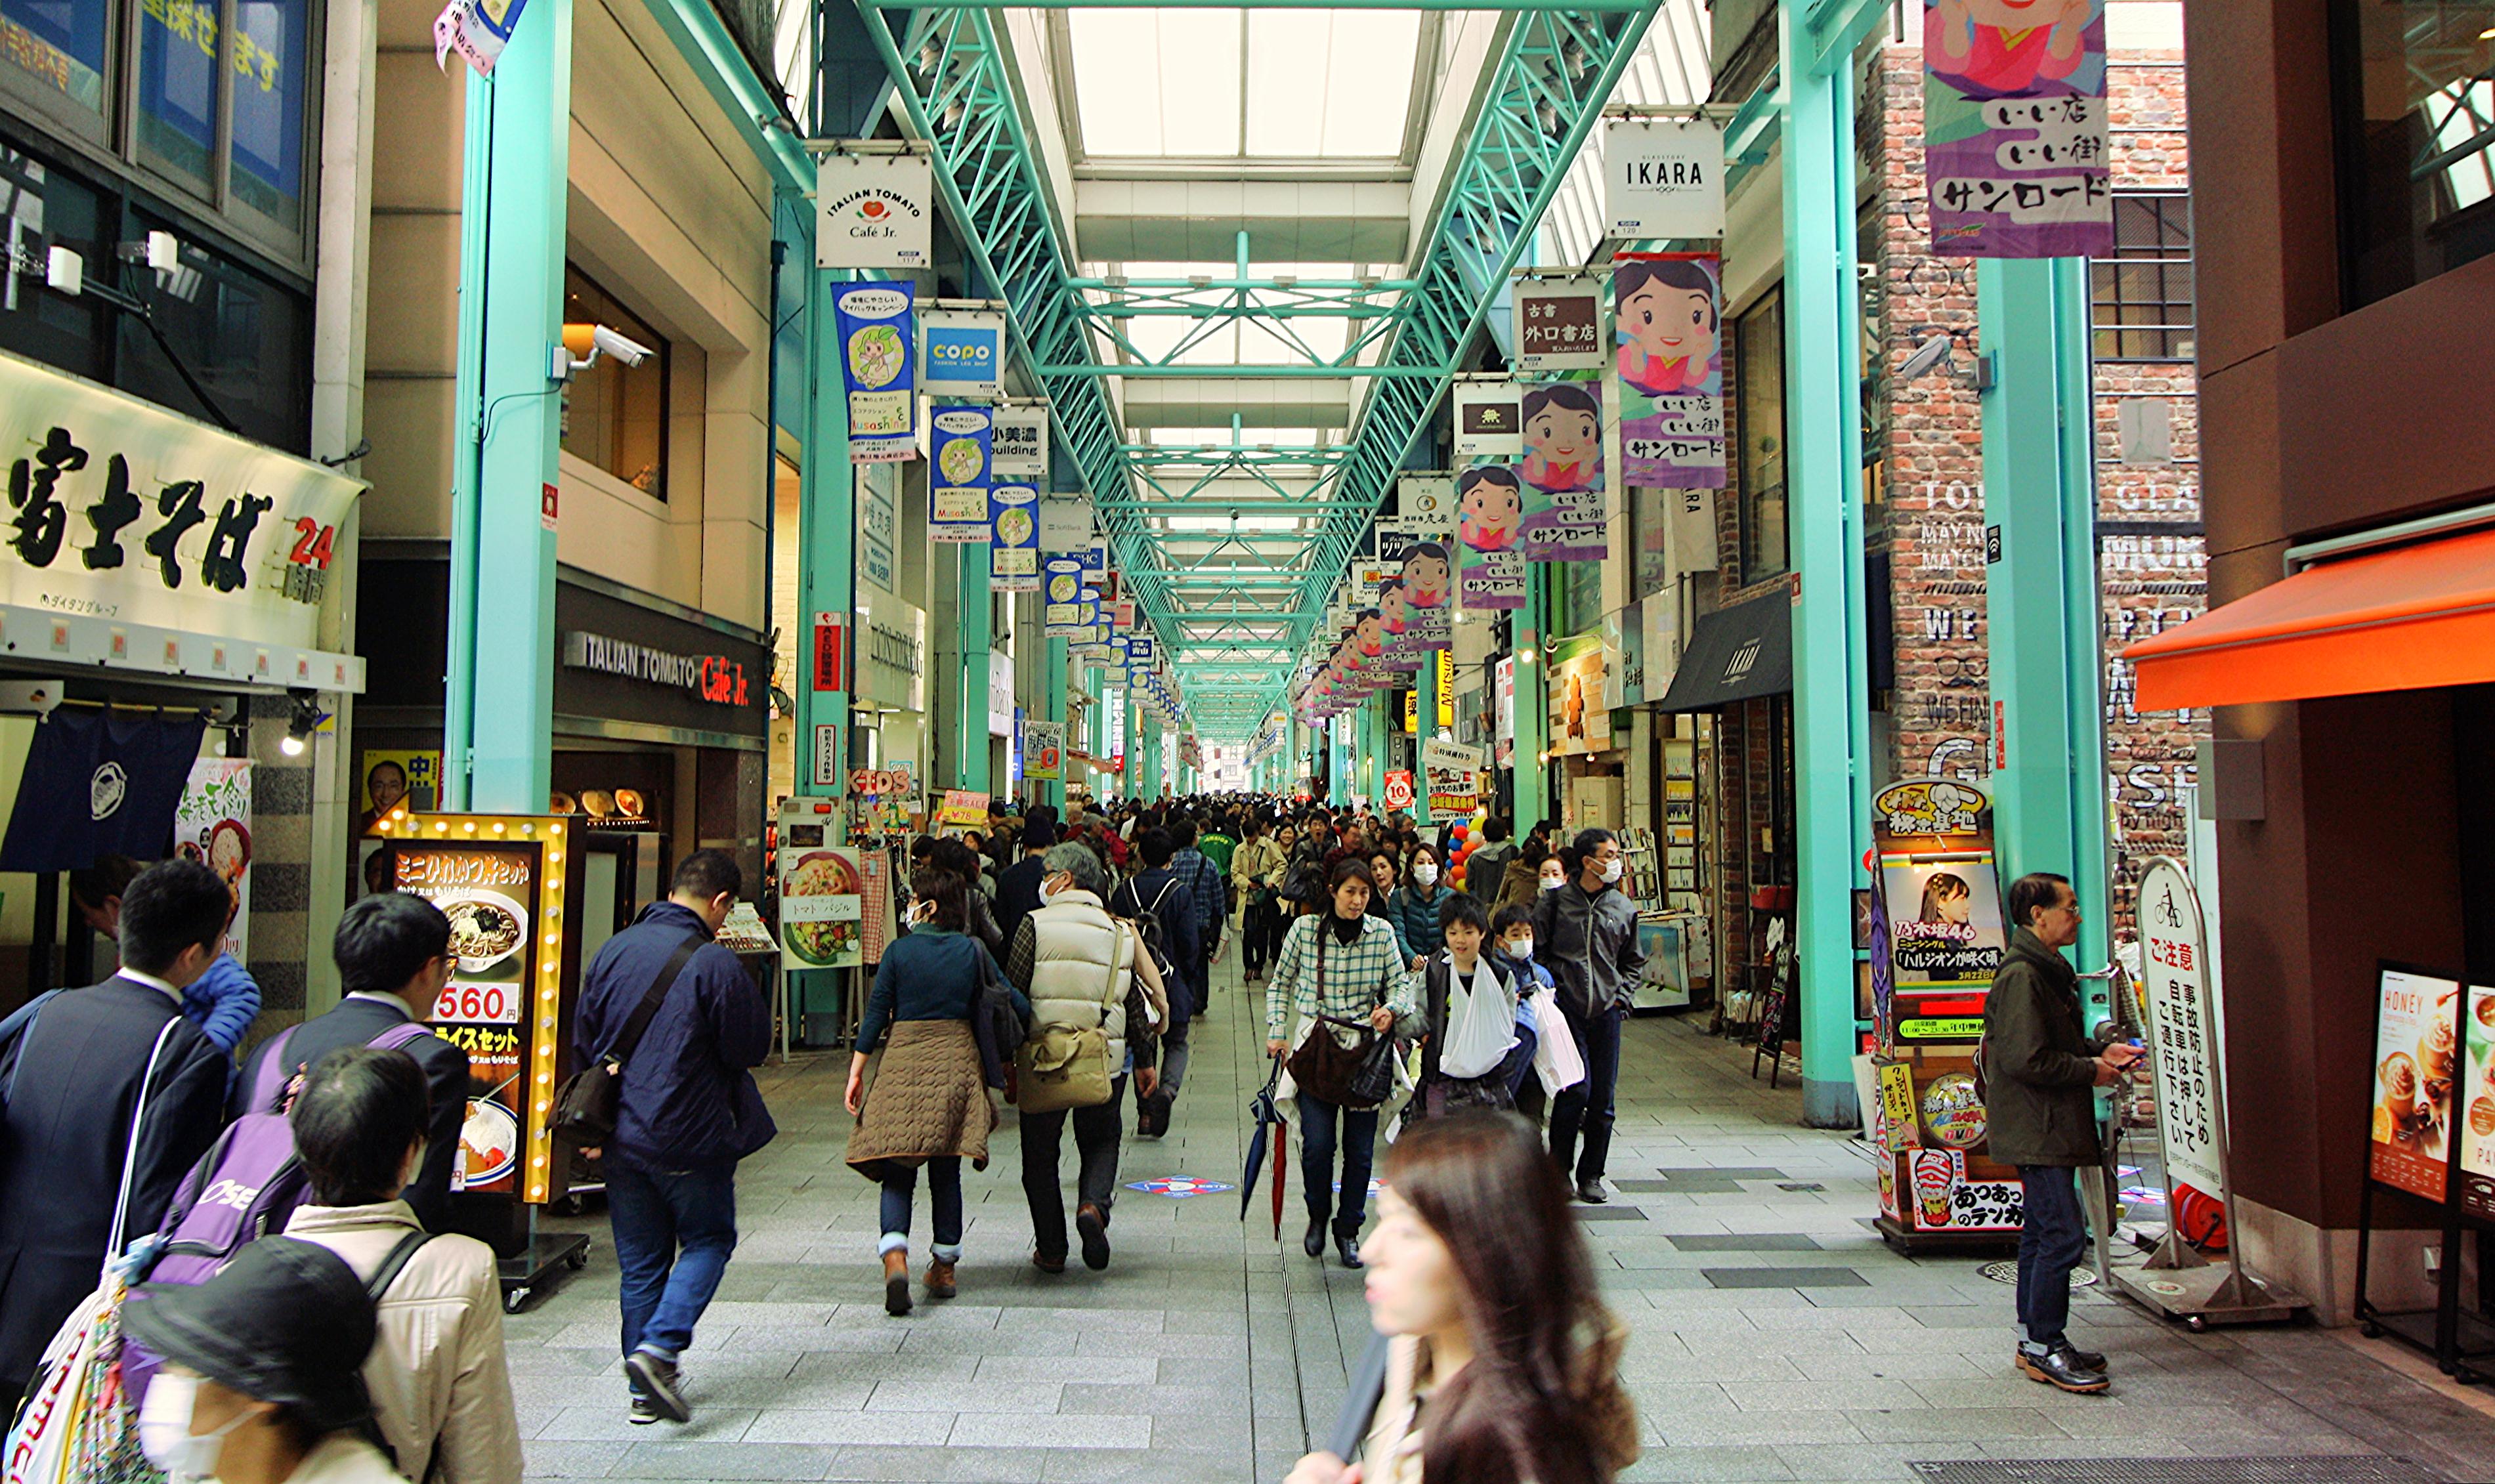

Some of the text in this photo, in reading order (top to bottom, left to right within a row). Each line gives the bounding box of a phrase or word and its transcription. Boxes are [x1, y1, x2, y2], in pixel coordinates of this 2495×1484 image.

[1999, 93, 2087, 125] いい店
[2010, 135, 2100, 167] いい街
[1627, 163, 1702, 184] IKARA
[827, 188, 920, 218] ITALIAN TOMATO
[1942, 172, 2108, 213] サンロード
[850, 226, 897, 238] Café Jr.
[1527, 303, 1557, 318] 古書
[1524, 323, 1595, 343] 外口書店
[1662, 394, 1712, 412] いい店
[1669, 417, 1720, 436] いい街
[1632, 439, 1724, 459] サンロード
[1557, 490, 1597, 504] いい店
[289, 516, 335, 570] 24
[1533, 525, 1607, 543] サンロード
[1468, 579, 1524, 592] サンロード
[1408, 629, 1452, 639] サンロード
[1924, 608, 1977, 641] WE
[583, 633, 750, 707] ITALIAN TOMATO Café Jr.
[1025, 725, 1053, 735] iPhone
[823, 729, 832, 780] 防犯カメラ作動中
[409, 756, 429, 777] 中
[847, 769, 910, 795] KIDS
[1391, 786, 1405, 797] 10
[1888, 809, 1978, 834] 秘密基地
[824, 903, 851, 913] バジル
[1895, 920, 1976, 941] 乃木坂46
[1899, 939, 1946, 949] ニューシングル
[2150, 938, 2194, 971] ご注意
[438, 987, 516, 1020] 560 円
[2384, 990, 2424, 1015] HONEY
[2159, 1000, 2183, 1145] ご通行下さい
[2169, 979, 2196, 1153] 自転車は押して
[2183, 983, 2209, 1145] 事故防止のため
[1923, 1153, 1946, 1165] HOT
[2477, 1147, 2495, 1169] PA
[1953, 1183, 2022, 1210] あつあつ
